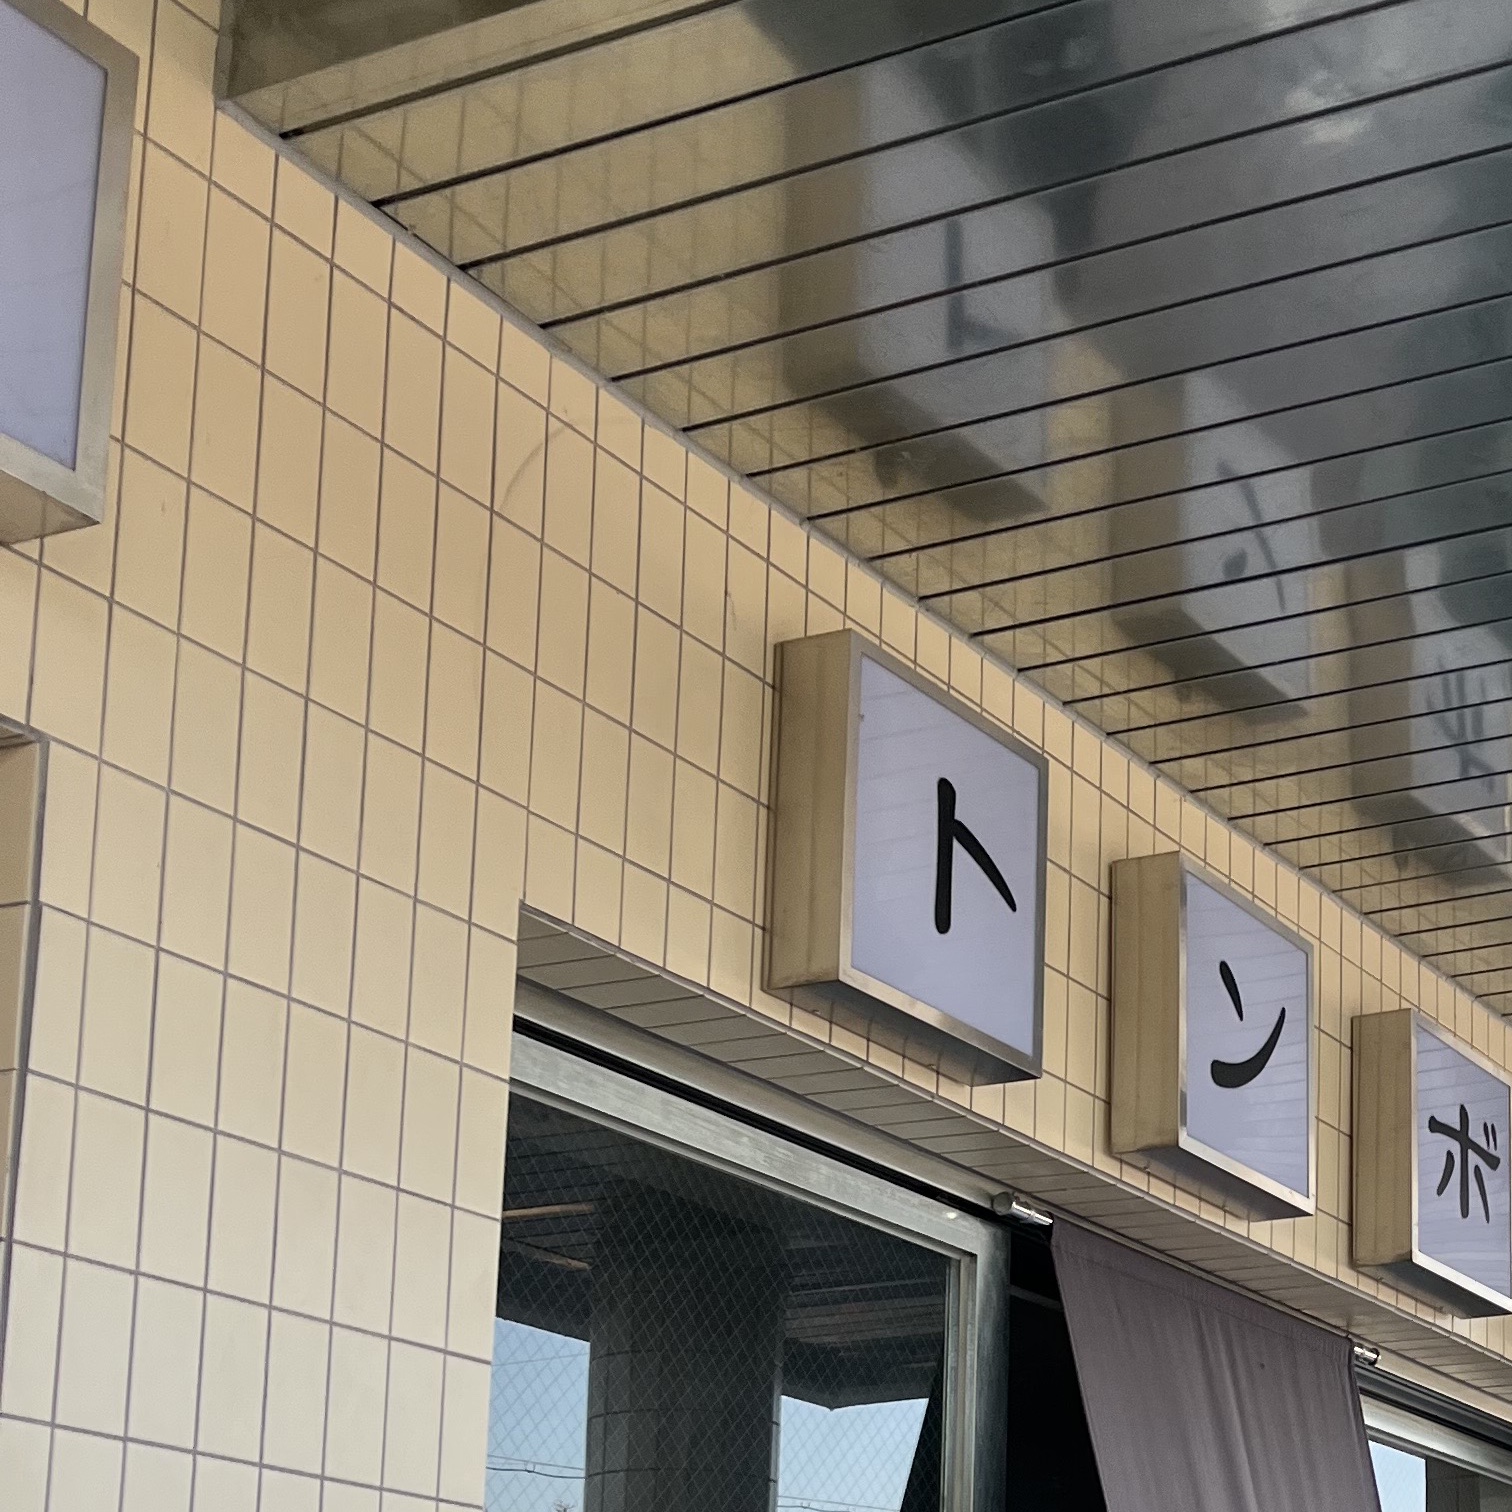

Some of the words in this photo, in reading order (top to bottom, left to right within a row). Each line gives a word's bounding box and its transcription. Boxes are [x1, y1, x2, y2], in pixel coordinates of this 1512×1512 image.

[934, 776, 1017, 935] ト
[1210, 960, 1287, 1089] ン
[1428, 1103, 1501, 1224] ボ
